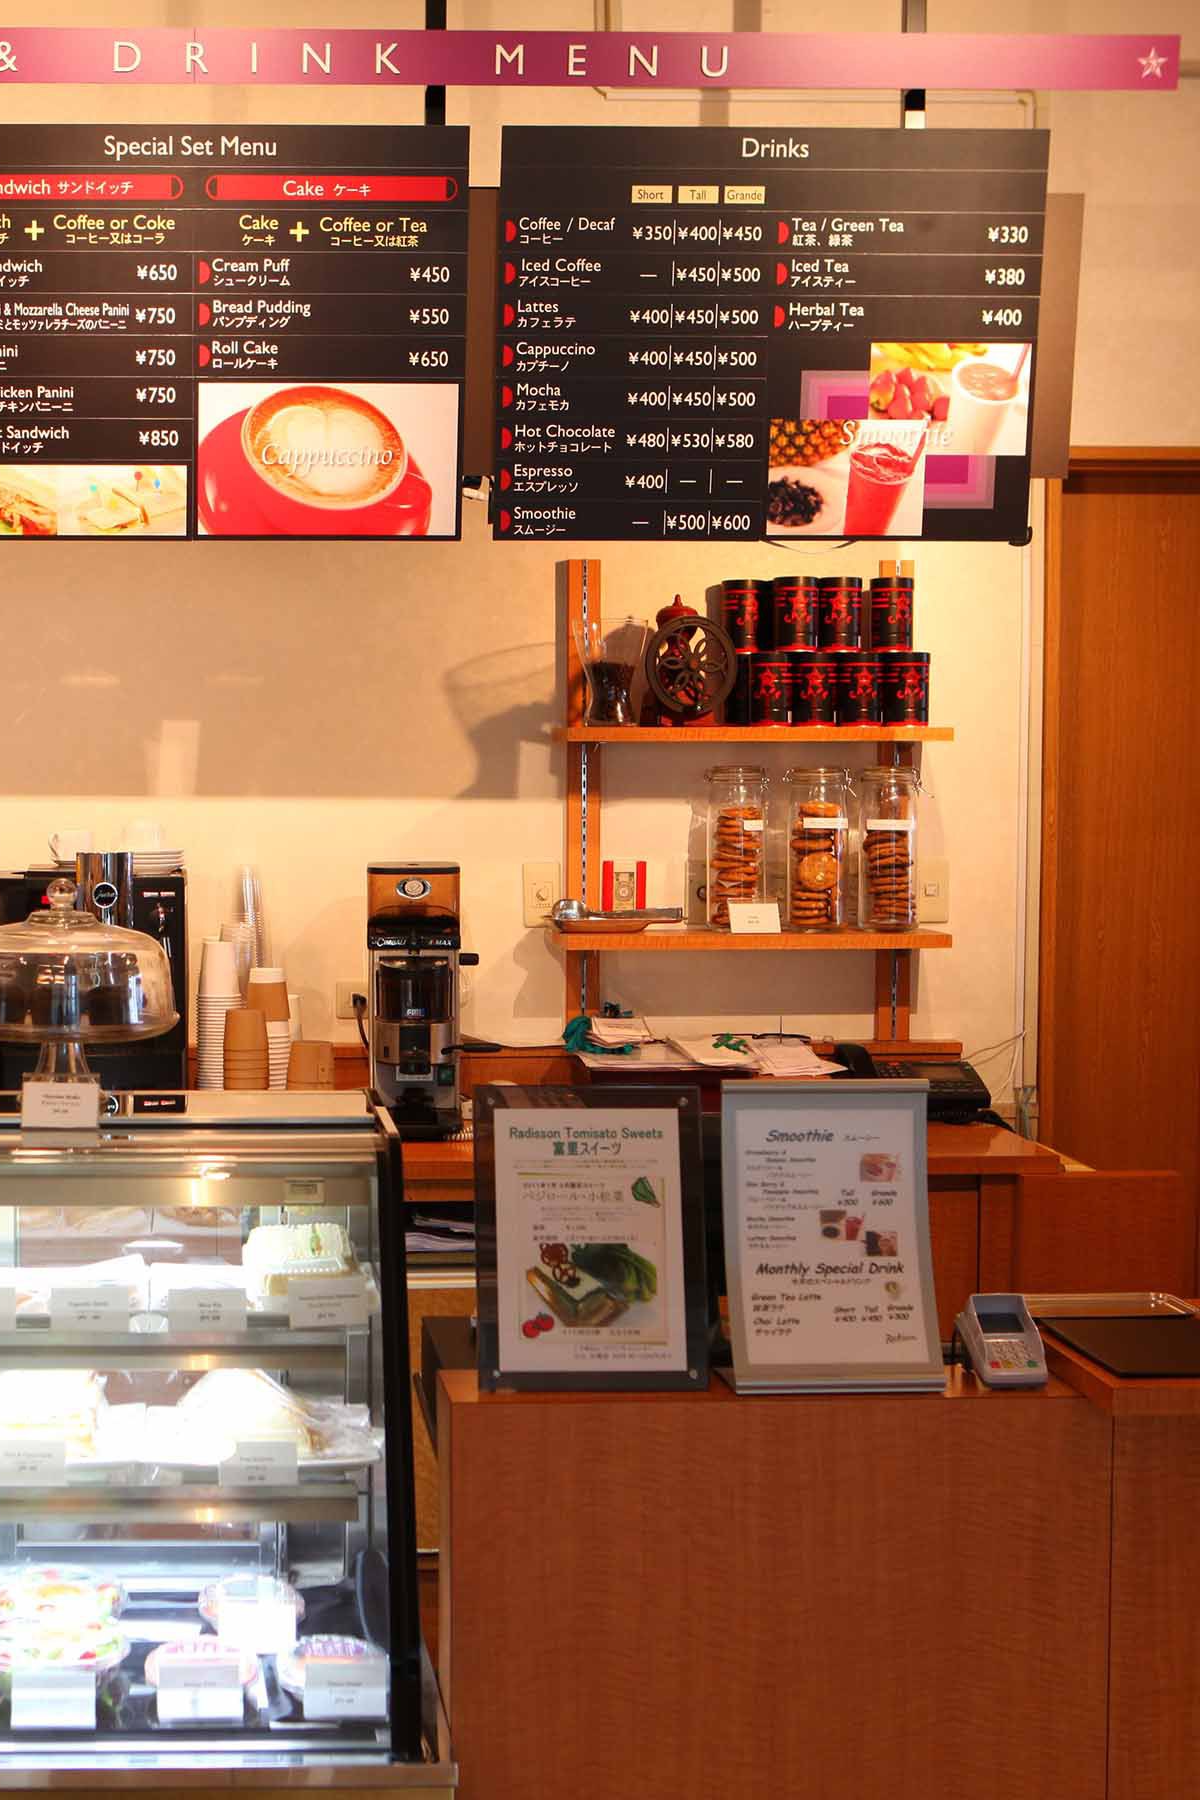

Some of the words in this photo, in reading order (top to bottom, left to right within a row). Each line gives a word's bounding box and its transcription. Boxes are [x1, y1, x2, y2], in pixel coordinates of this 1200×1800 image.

[112, 41, 401, 73] DRINK
[495, 44, 729, 78] MENU
[105, 136, 173, 159] Special
[181, 136, 213, 155] Set
[221, 136, 276, 155] Menu
[742, 138, 808, 157] Drinks
[58, 181, 133, 194] サンドイッチ
[283, 181, 323, 196] Cake
[334, 184, 371, 196] ケーキ
[636, 188, 666, 202] Short
[689, 188, 708, 202] Tall
[726, 189, 763, 203] Grande
[54, 215, 104, 229] Coffee
[110, 220, 128, 229] or
[134, 215, 175, 229] Coke
[240, 215, 278, 229] Cake
[320, 217, 370, 232] Coffee
[376, 222, 394, 232] or
[399, 218, 427, 232] Tea
[520, 217, 560, 230] Coffee
[579, 218, 615, 230] Decaf
[792, 218, 816, 231] Tea
[831, 218, 874, 231] Green
[879, 218, 904, 232] Tea
[520, 234, 563, 244] コーヒー
[633, 226, 672, 240] ¥350
[679, 226, 717, 240] ¥400
[723, 227, 762, 240] ¥450
[989, 227, 1028, 243] ¥330
[242, 235, 275, 246] ケーキ
[212, 258, 258, 272] Cream
[264, 259, 290, 272] Puff
[522, 259, 548, 271] Iced
[556, 259, 601, 271] Coffee
[792, 259, 819, 272] Iced
[824, 259, 849, 272] Tea
[137, 265, 177, 280] ¥650
[411, 267, 449, 282] ¥450
[985, 268, 1025, 285] ¥380
[520, 276, 590, 287] アイスコーヒー
[791, 276, 856, 287] アイスティー
[14, 303, 62, 315] Mozzarella
[66, 303, 99, 316] Cheese
[103, 303, 129, 316] Panini
[213, 300, 252, 313] Bread
[256, 300, 310, 318] Pudding
[518, 300, 558, 312] Lattes
[790, 303, 832, 316] Herbal
[840, 303, 864, 316] Tea
[410, 309, 449, 324] ¥550
[518, 317, 576, 328] カフェラテ
[983, 309, 1022, 325] ¥400
[789, 319, 854, 331] ハーブティー
[212, 341, 238, 354] Roll
[244, 341, 278, 354] Cake
[517, 342, 595, 358] Cappuccino
[213, 358, 278, 369] ロールケーキ
[409, 352, 448, 366] ¥650
[38, 386, 73, 398] Panini
[517, 384, 560, 396] Mocha
[516, 400, 569, 410] カフェモカ
[7, 426, 69, 439] Sandwich
[139, 430, 178, 446] ¥850
[515, 425, 540, 437] Hot
[546, 425, 615, 437] Chocolate
[515, 441, 611, 453] ホットチョコレート
[627, 434, 665, 447] ¥480
[672, 434, 709, 447] ¥530
[716, 434, 753, 448] ¥580
[261, 443, 394, 478] Cappuccino
[514, 464, 572, 480] Espresso
[514, 507, 575, 519] Smoothie
[514, 525, 565, 535] スムージー
[509, 1127, 561, 1139] Radisson
[566, 1127, 618, 1139] Tomisato
[621, 1127, 664, 1140] Sweets
[765, 1129, 834, 1142] Smoothie
[755, 1262, 810, 1277] Monthly
[815, 1262, 863, 1277] Special
[868, 1262, 905, 1275] Drink
